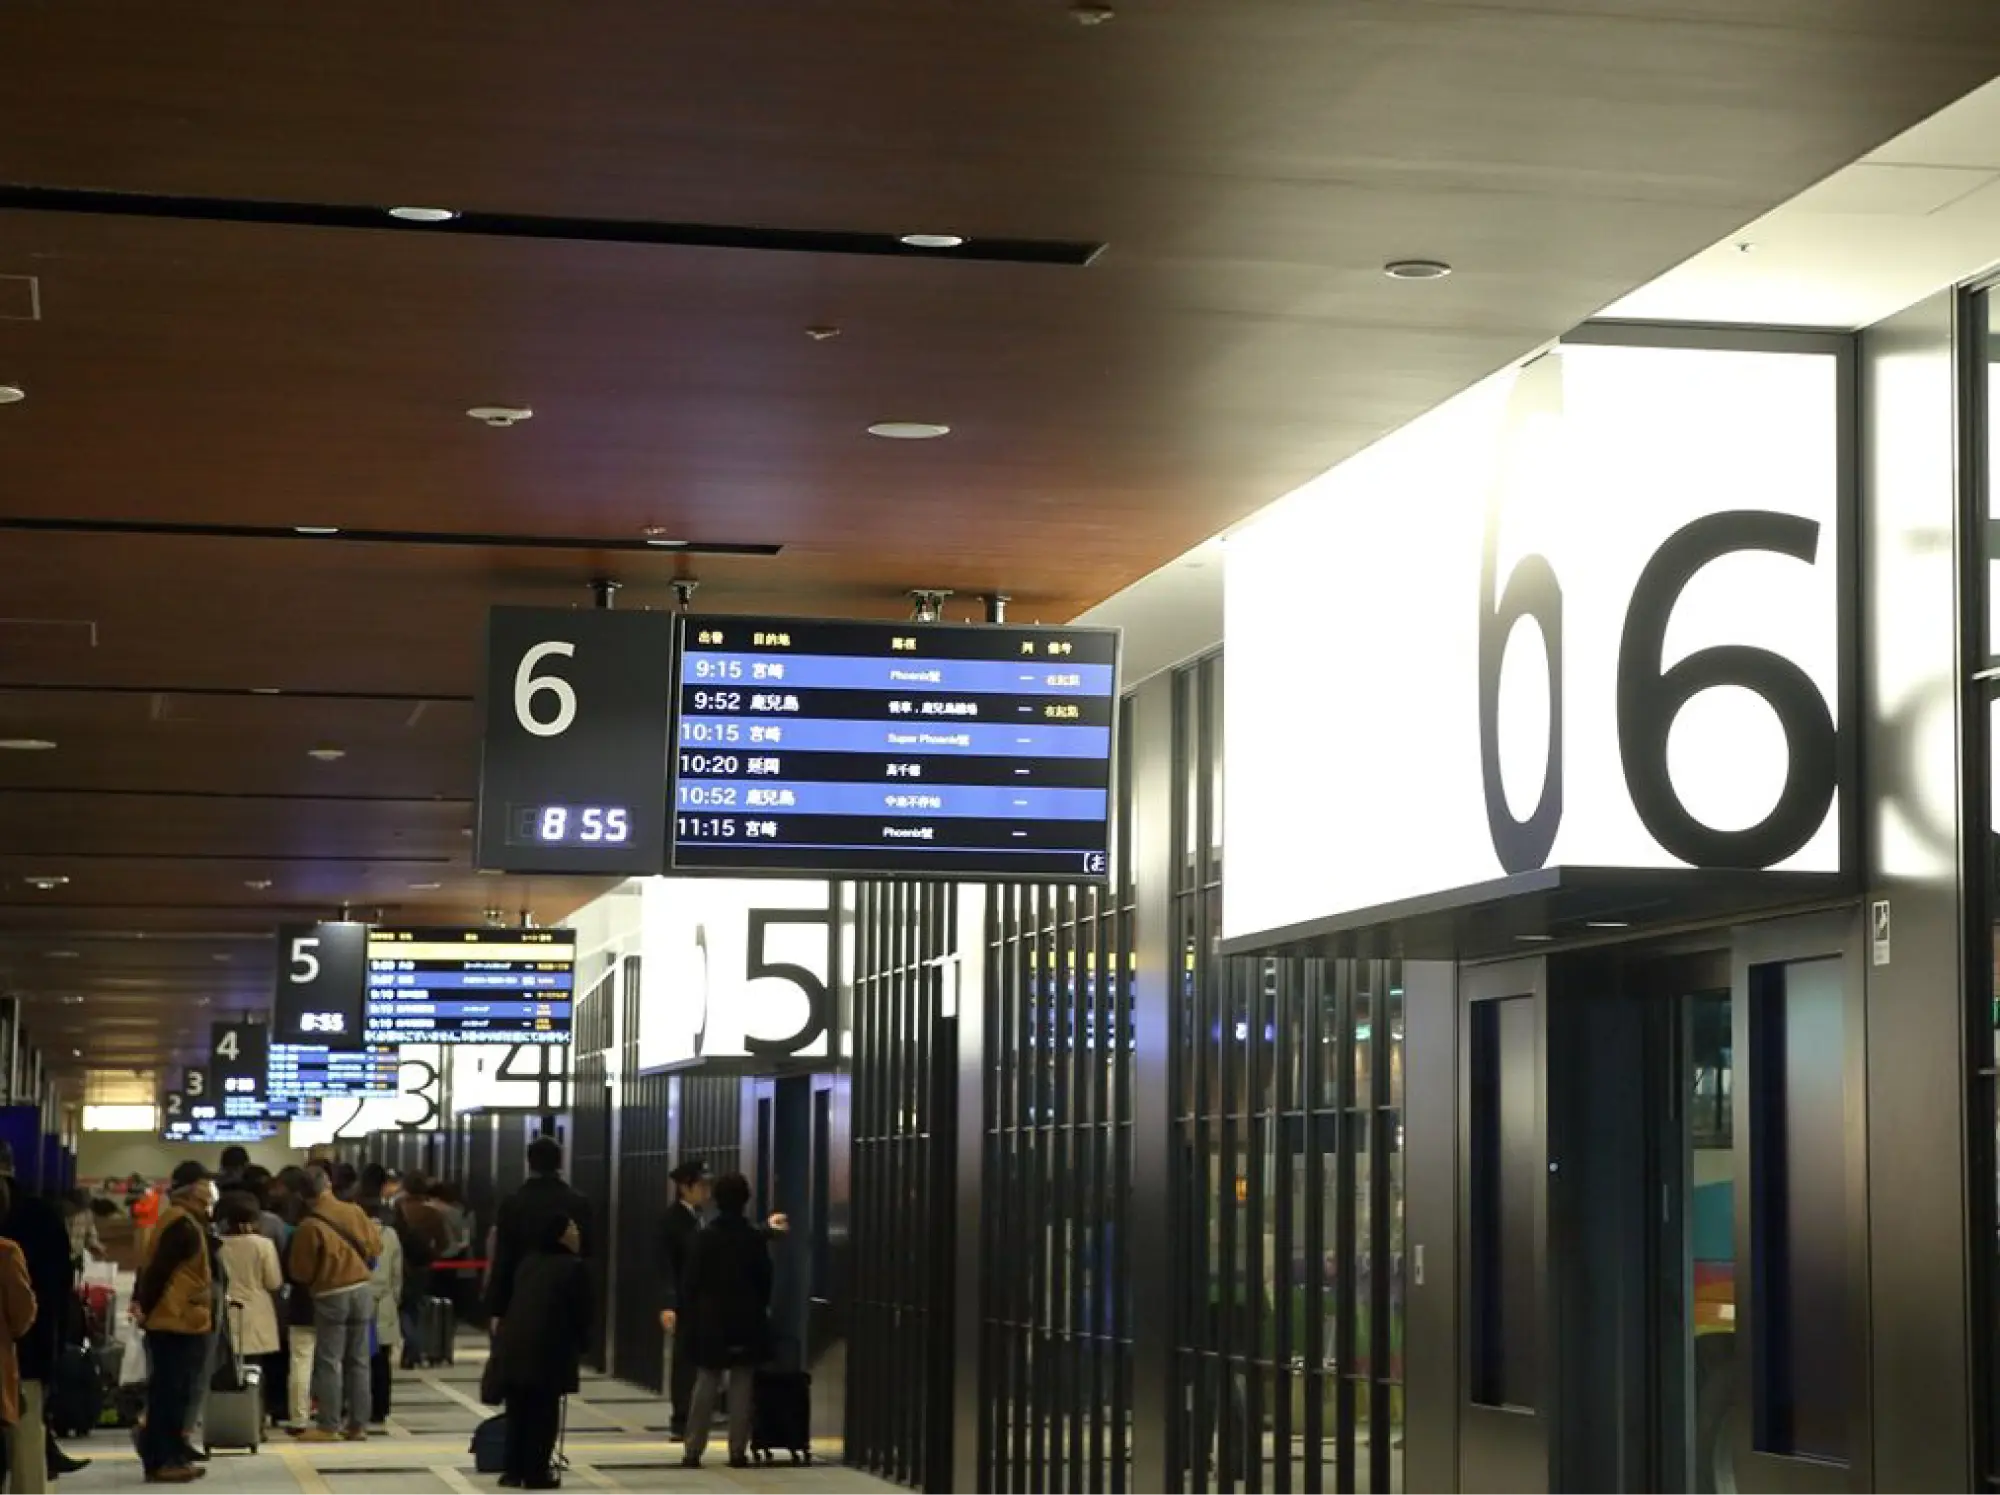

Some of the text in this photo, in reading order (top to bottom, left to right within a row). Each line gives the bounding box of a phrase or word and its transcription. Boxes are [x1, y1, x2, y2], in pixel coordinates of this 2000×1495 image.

[696, 660, 742, 678] 9:15
[515, 641, 577, 737] 6
[694, 691, 741, 710] 9:52
[1617, 509, 1838, 870] 6
[682, 722, 740, 741] 10:15
[680, 755, 739, 773] 10:20
[680, 787, 737, 805] 10:52
[678, 818, 736, 836] 11:15
[289, 938, 320, 983] 5
[744, 908, 830, 1057] 5
[216, 1030, 240, 1061] 4
[186, 1070, 203, 1096] 3
[394, 1059, 437, 1129] 3
[168, 1094, 182, 1114] 2
